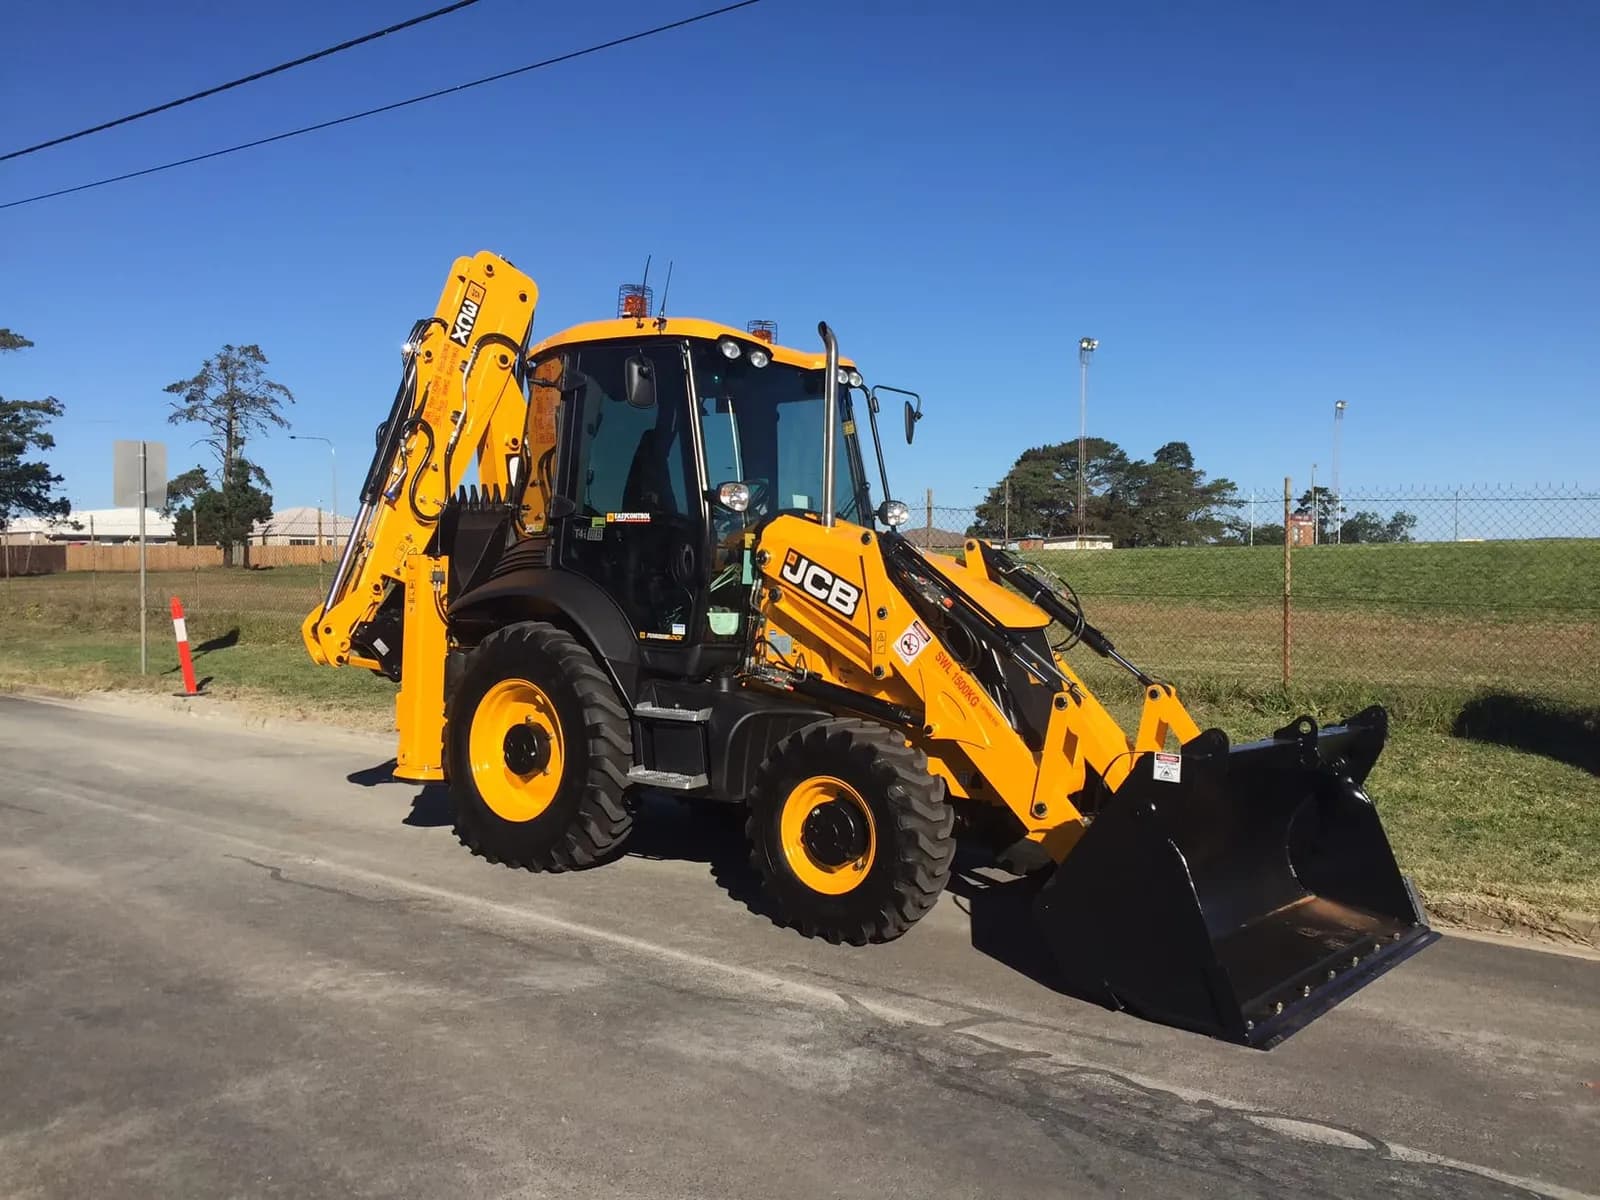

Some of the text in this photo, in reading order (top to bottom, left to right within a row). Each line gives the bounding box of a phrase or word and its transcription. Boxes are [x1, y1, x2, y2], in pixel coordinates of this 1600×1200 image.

[451, 299, 478, 345] 3CX
[782, 557, 859, 616] JCB
[935, 651, 979, 707] SWL 1500KG
